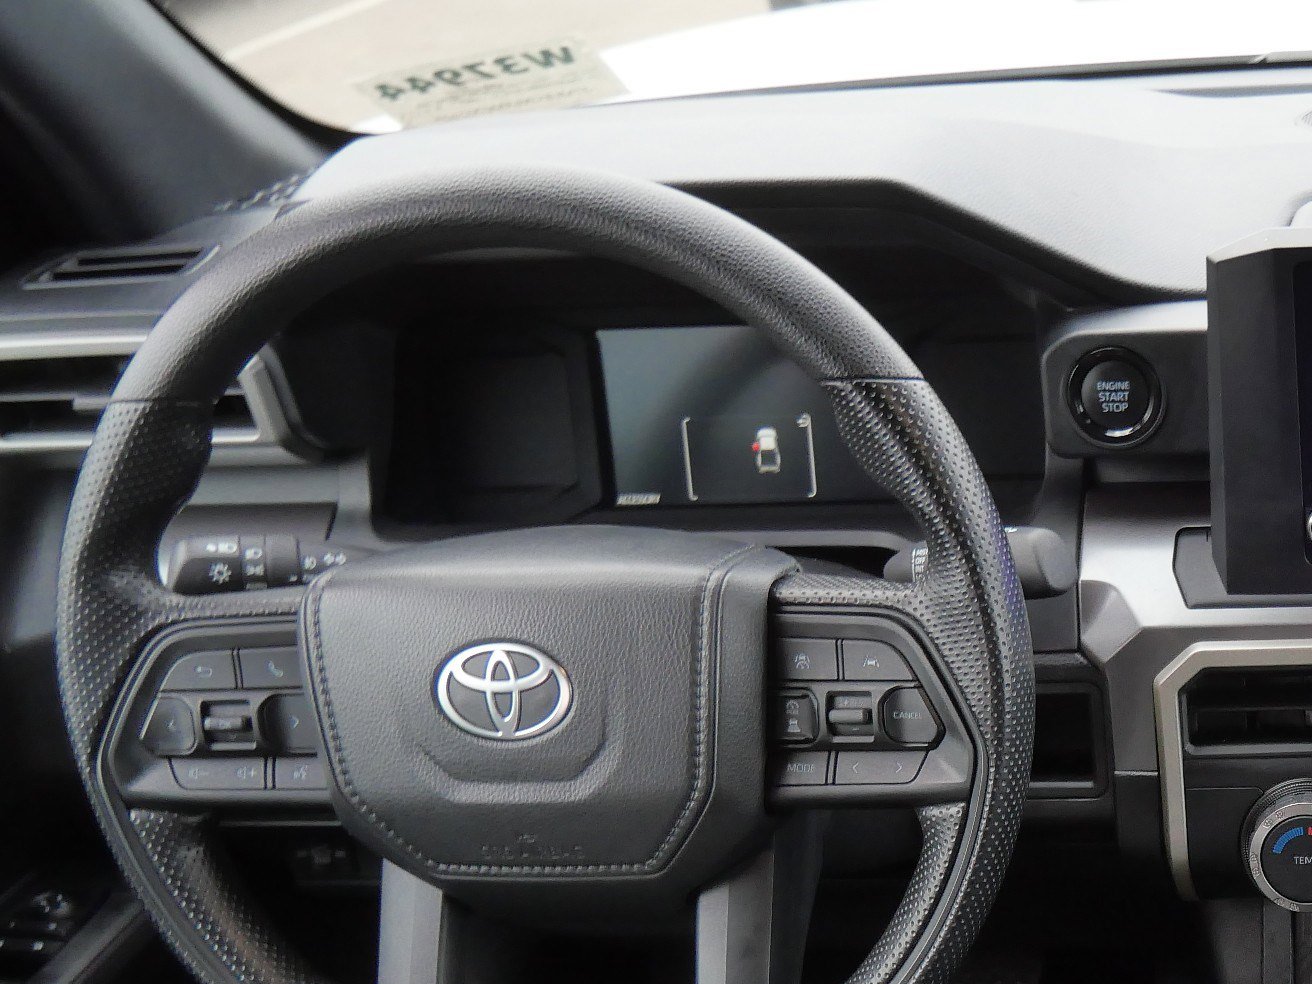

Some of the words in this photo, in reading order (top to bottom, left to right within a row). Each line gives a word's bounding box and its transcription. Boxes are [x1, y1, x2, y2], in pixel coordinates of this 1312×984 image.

[1097, 381, 1131, 391] ENGINE
[1098, 391, 1129, 402] START
[1101, 402, 1129, 413] STOP
